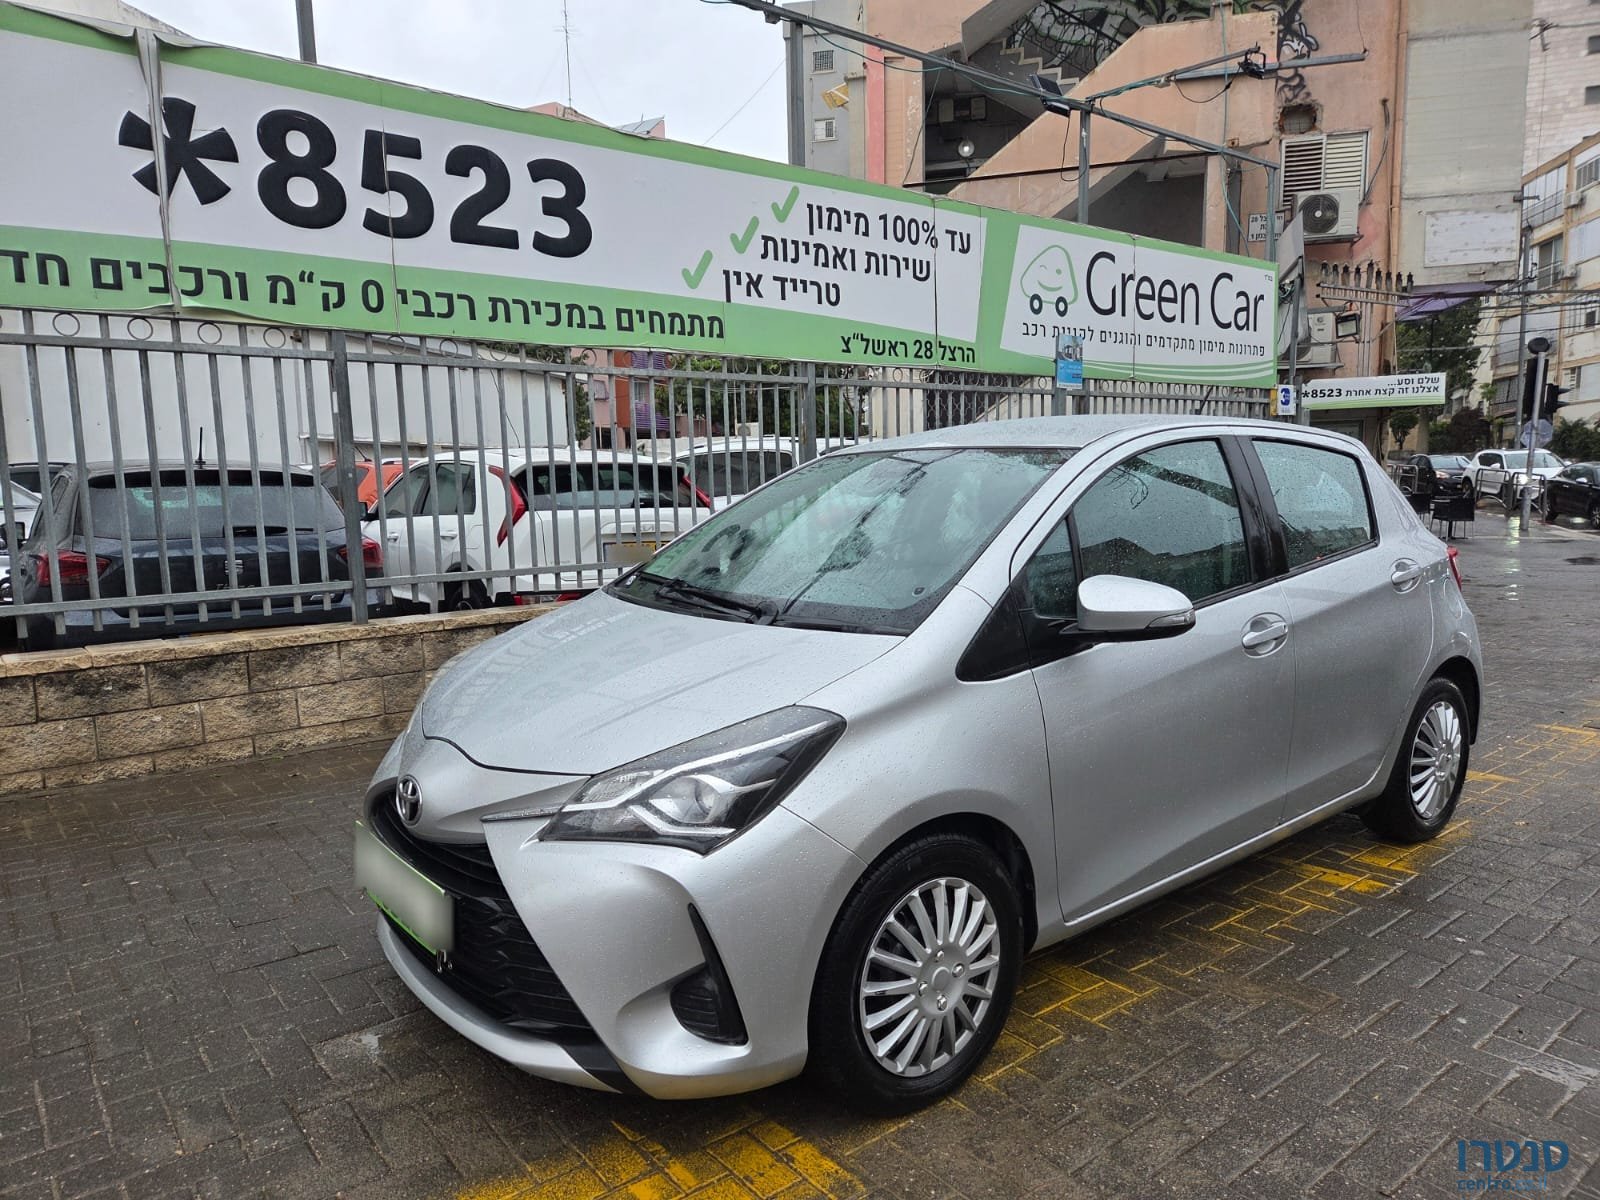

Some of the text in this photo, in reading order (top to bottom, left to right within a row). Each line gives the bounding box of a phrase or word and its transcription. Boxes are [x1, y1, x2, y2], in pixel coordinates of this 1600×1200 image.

[806, 203, 971, 254] עד 100% מימון
[761, 235, 931, 282] שירות ואמינות
[90, 257, 248, 301] ורכבים
[722, 269, 841, 306] טרייד אין
[361, 279, 384, 313] 0
[1086, 251, 1264, 332] Green Car
[396, 288, 476, 320] רכבי
[488, 296, 606, 330] במכירת
[616, 307, 724, 338] מתמחים
[1022, 322, 1046, 337] רכב
[1100, 330, 1141, 346] והוגנים
[1146, 335, 1195, 352] מתקדמים
[1199, 339, 1224, 354] מימון
[913, 340, 933, 359] 28
[938, 341, 976, 363] הרצל
[1228, 342, 1265, 357] פתרונות
[1398, 386, 1409, 394] זה
[1412, 385, 1440, 394] אצלנו
[1417, 376, 1440, 385] שלם
[1374, 387, 1395, 396] קצת
